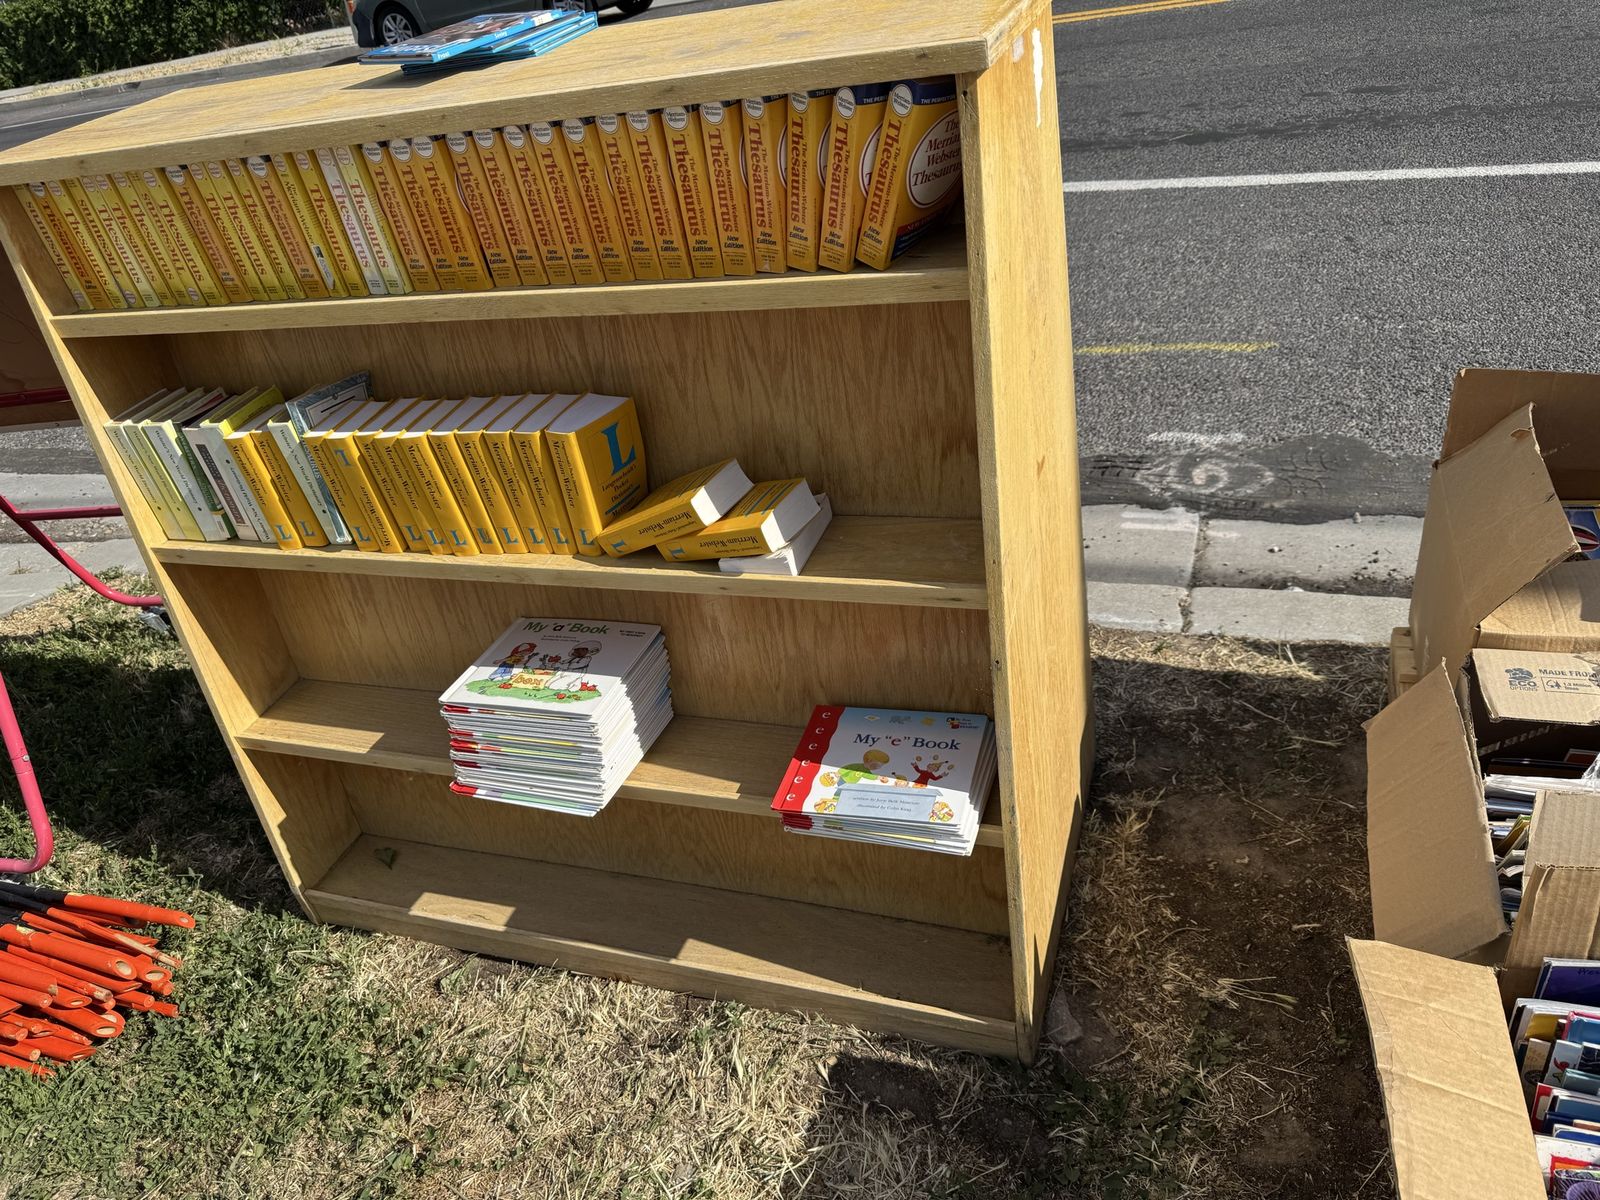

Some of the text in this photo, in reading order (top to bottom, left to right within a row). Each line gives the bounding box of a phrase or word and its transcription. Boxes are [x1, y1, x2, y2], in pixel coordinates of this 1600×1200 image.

[946, 119, 959, 133] The
[483, 151, 521, 246] Thesaurus
[514, 151, 551, 247] Thesaurus
[540, 147, 577, 246] Thesaurus
[572, 145, 607, 245] Thesaurus
[606, 136, 637, 238] Thesaurus
[636, 134, 668, 237] Thesaurus
[672, 133, 701, 238] Thesaurus
[708, 127, 733, 233] Thesaurus
[748, 122, 767, 229] Thesaurus
[790, 115, 805, 223] Thesaurus
[827, 122, 849, 229] Thesaurus
[869, 119, 902, 224] Thesaurus
[142, 193, 185, 275] Thesaurus
[179, 187, 224, 270] Thesaurus
[205, 193, 248, 275] Thesaurus
[223, 191, 266, 275] Thesaurus
[243, 190, 284, 274] Thesaurus
[260, 180, 304, 266] Thesaurus
[310, 183, 349, 271] Thesaurus
[330, 179, 370, 268] Thesaurus
[349, 178, 389, 268] Thesaurus
[374, 166, 413, 256] Thesaurus
[401, 165, 440, 256] Thesaurus
[423, 161, 462, 254] Thesaurus
[456, 156, 494, 250] Thesaurus
[760, 230, 773, 238] New
[793, 225, 805, 233] New
[828, 231, 842, 239] New
[868, 225, 881, 236] New
[64, 208, 109, 286] Thesaurus
[79, 199, 123, 276] Thesaurus
[98, 204, 142, 284] Thesaurus
[112, 202, 157, 282] Thesaurus
[129, 199, 174, 280] Thesaurus
[159, 199, 204, 281] Thesaurus
[693, 245, 714, 253] Edition
[724, 241, 745, 249] Edition
[757, 237, 777, 246] Edition
[789, 232, 809, 241] Edition
[824, 237, 845, 249] Edition
[863, 232, 884, 246] Edition
[175, 464, 187, 481] World
[231, 444, 266, 506] Merriam-Webster
[258, 440, 292, 502] Merriam-Webster
[300, 465, 311, 482] World
[311, 444, 345, 508] Merriam-Webster
[363, 442, 396, 507] Merriam-Webster
[384, 445, 419, 511] Merriam-Webster
[408, 444, 441, 510] Merriam-Webster
[436, 441, 466, 507] Merriam-Webster
[464, 440, 495, 508] Merriam-Webster
[491, 440, 521, 508] Merriam-Webster
[519, 439, 546, 507] Merriam-Webster
[552, 439, 575, 509] Merriam-Webster
[601, 422, 637, 478] L
[274, 524, 293, 541] L
[300, 520, 316, 537] L
[354, 526, 371, 542] L
[360, 484, 393, 548] Merriam-Webster
[402, 525, 423, 541] L
[426, 529, 445, 545] L
[449, 529, 468, 546] L
[501, 527, 519, 544] L
[527, 527, 545, 544] L
[552, 527, 570, 544] L
[578, 528, 599, 546] L
[638, 510, 693, 534] Merriam-Webster
[699, 535, 759, 549] Merriam-Webster
[523, 621, 548, 633] My
[569, 623, 610, 635] Book
[1508, 680, 1537, 688] ECO
[1538, 668, 1568, 677] MADE
[808, 742, 818, 751] e
[815, 726, 825, 735] e
[822, 711, 831, 720] e
[853, 733, 881, 748] My
[912, 737, 962, 751] Book
[794, 775, 804, 784] e
[801, 759, 811, 768] e
[786, 793, 796, 802] e
